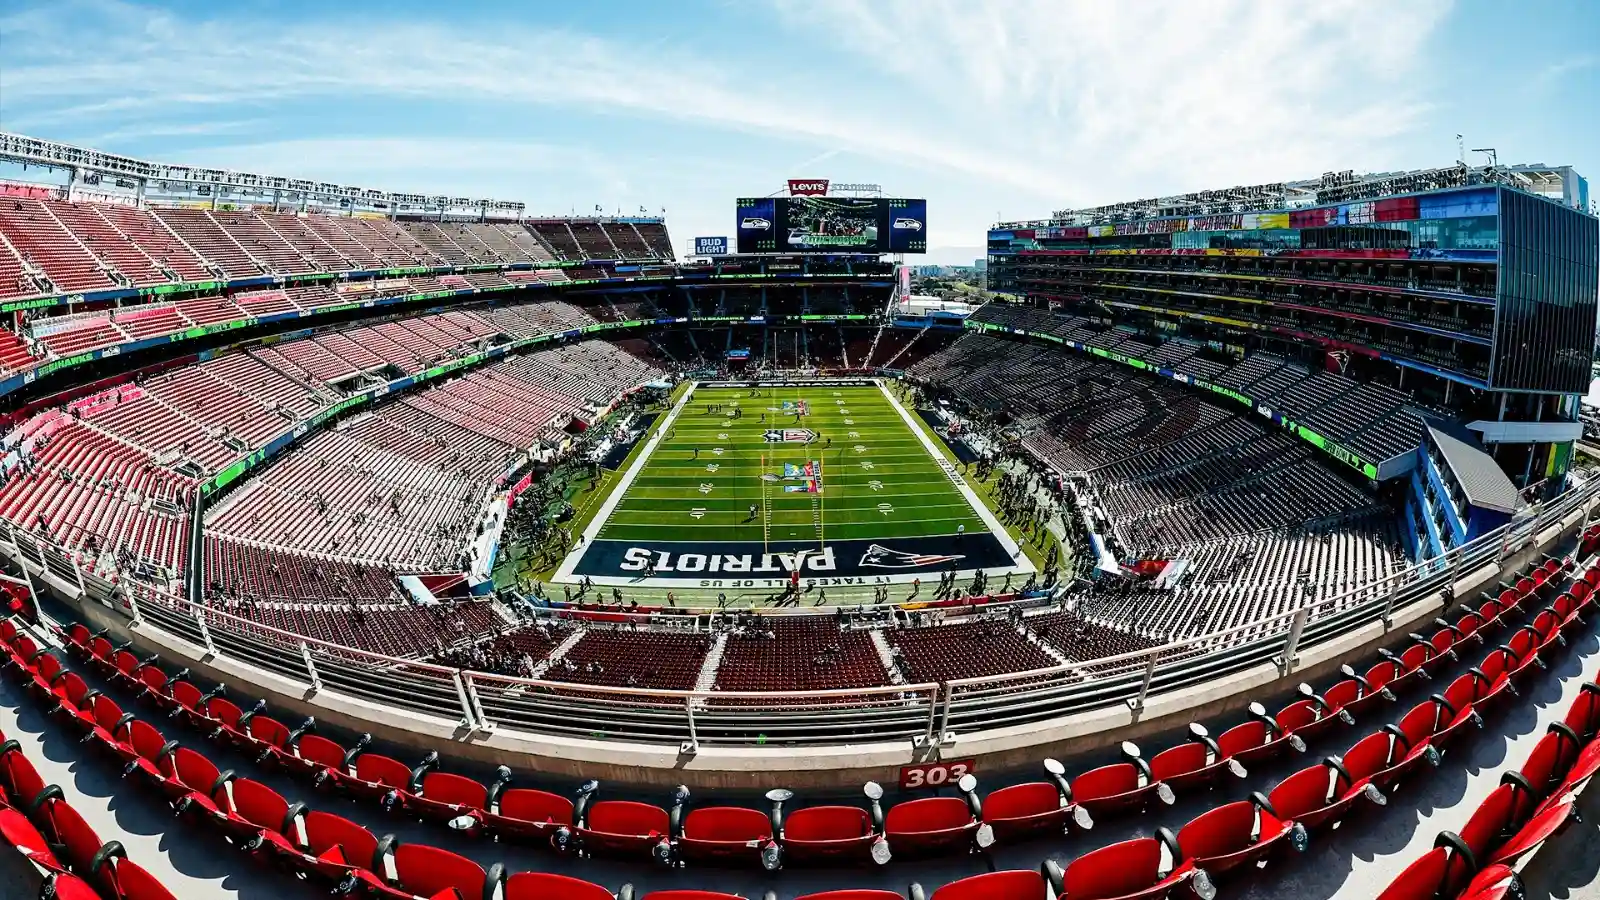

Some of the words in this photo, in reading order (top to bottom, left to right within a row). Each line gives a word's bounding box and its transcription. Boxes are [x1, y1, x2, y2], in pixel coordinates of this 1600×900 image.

[700, 238, 721, 246] BUD
[1, 298, 58, 312] SEAHAWKS
[48, 352, 93, 372] SEAHAWKS
[1212, 384, 1253, 407] SEAHAWKS
[620, 546, 837, 572] PATRIOTS
[807, 576, 866, 585] TAKES
[875, 576, 891, 584] IT
[905, 764, 968, 788] 303
